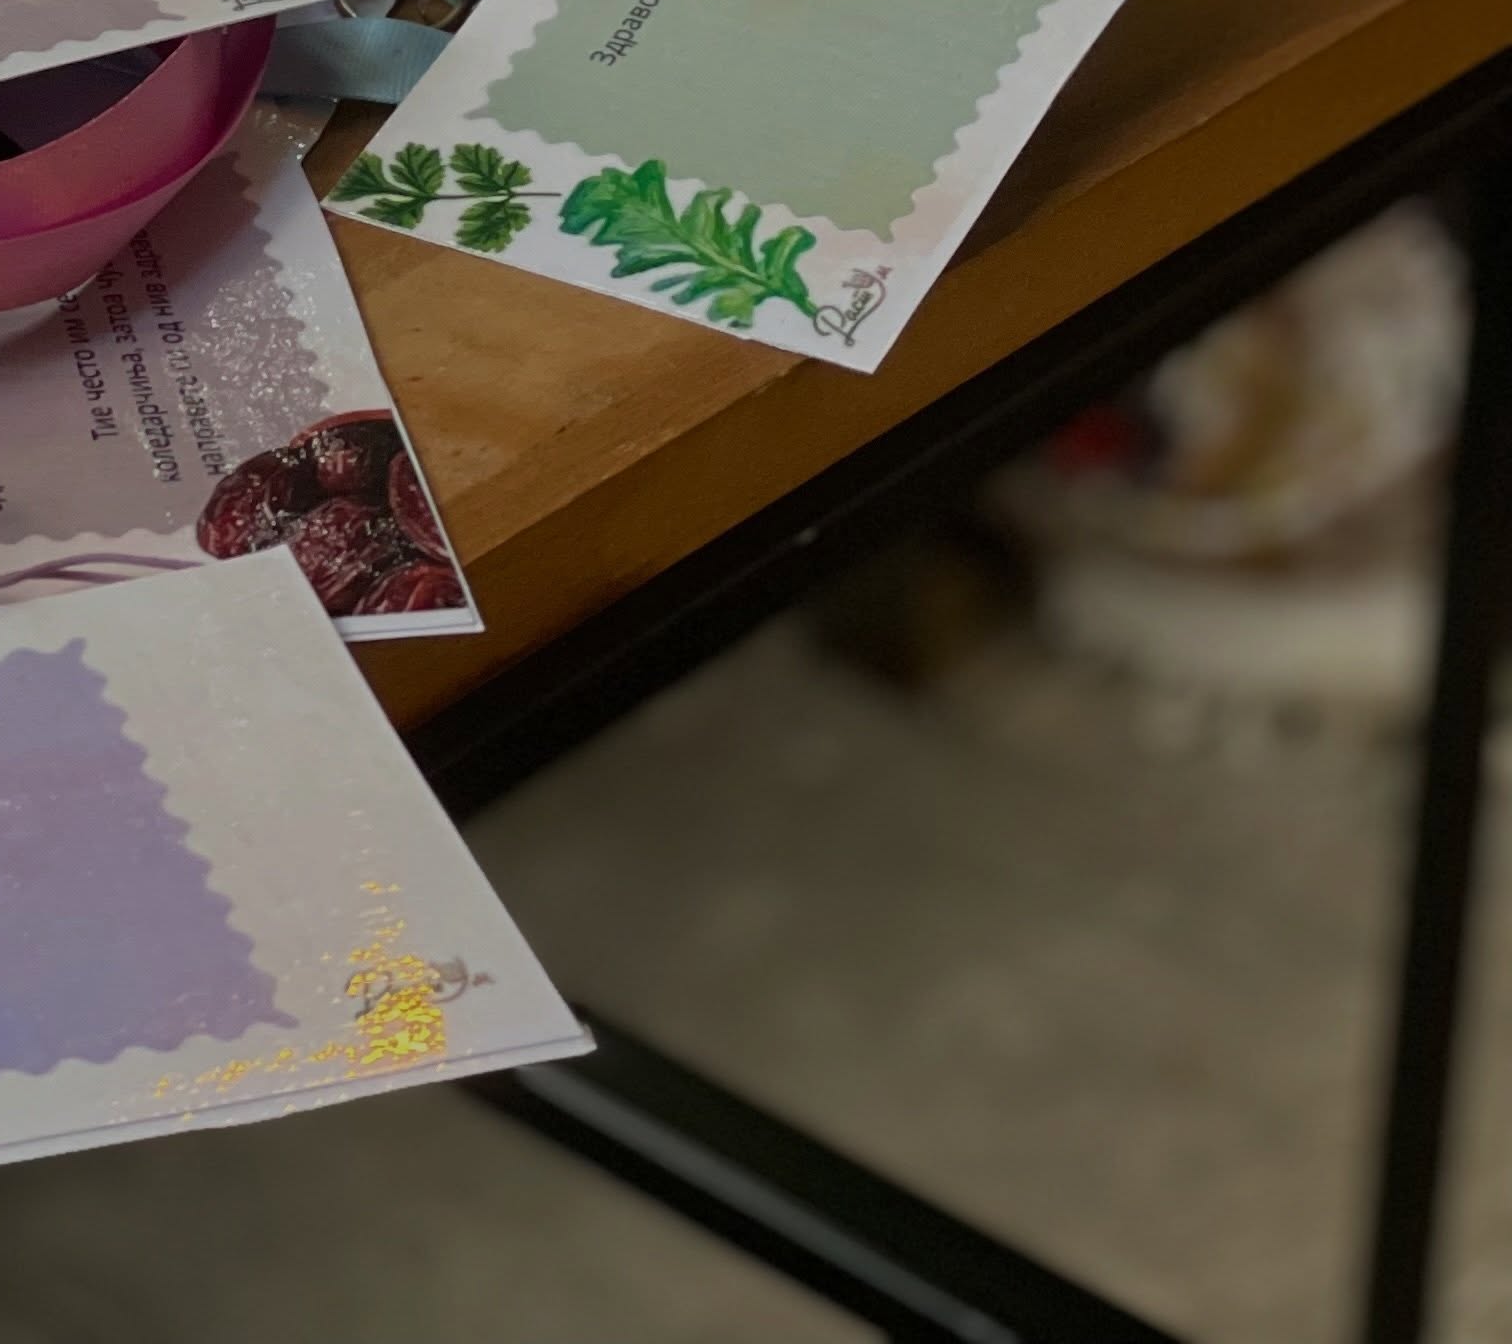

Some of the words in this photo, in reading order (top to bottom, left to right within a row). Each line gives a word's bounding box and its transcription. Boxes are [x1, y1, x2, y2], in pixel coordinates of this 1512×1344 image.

[146, 283, 174, 316] нив
[64, 318, 90, 344] им
[103, 293, 137, 344] затоа
[158, 321, 184, 345] од
[74, 350, 105, 401] често
[91, 406, 120, 441] Тие
